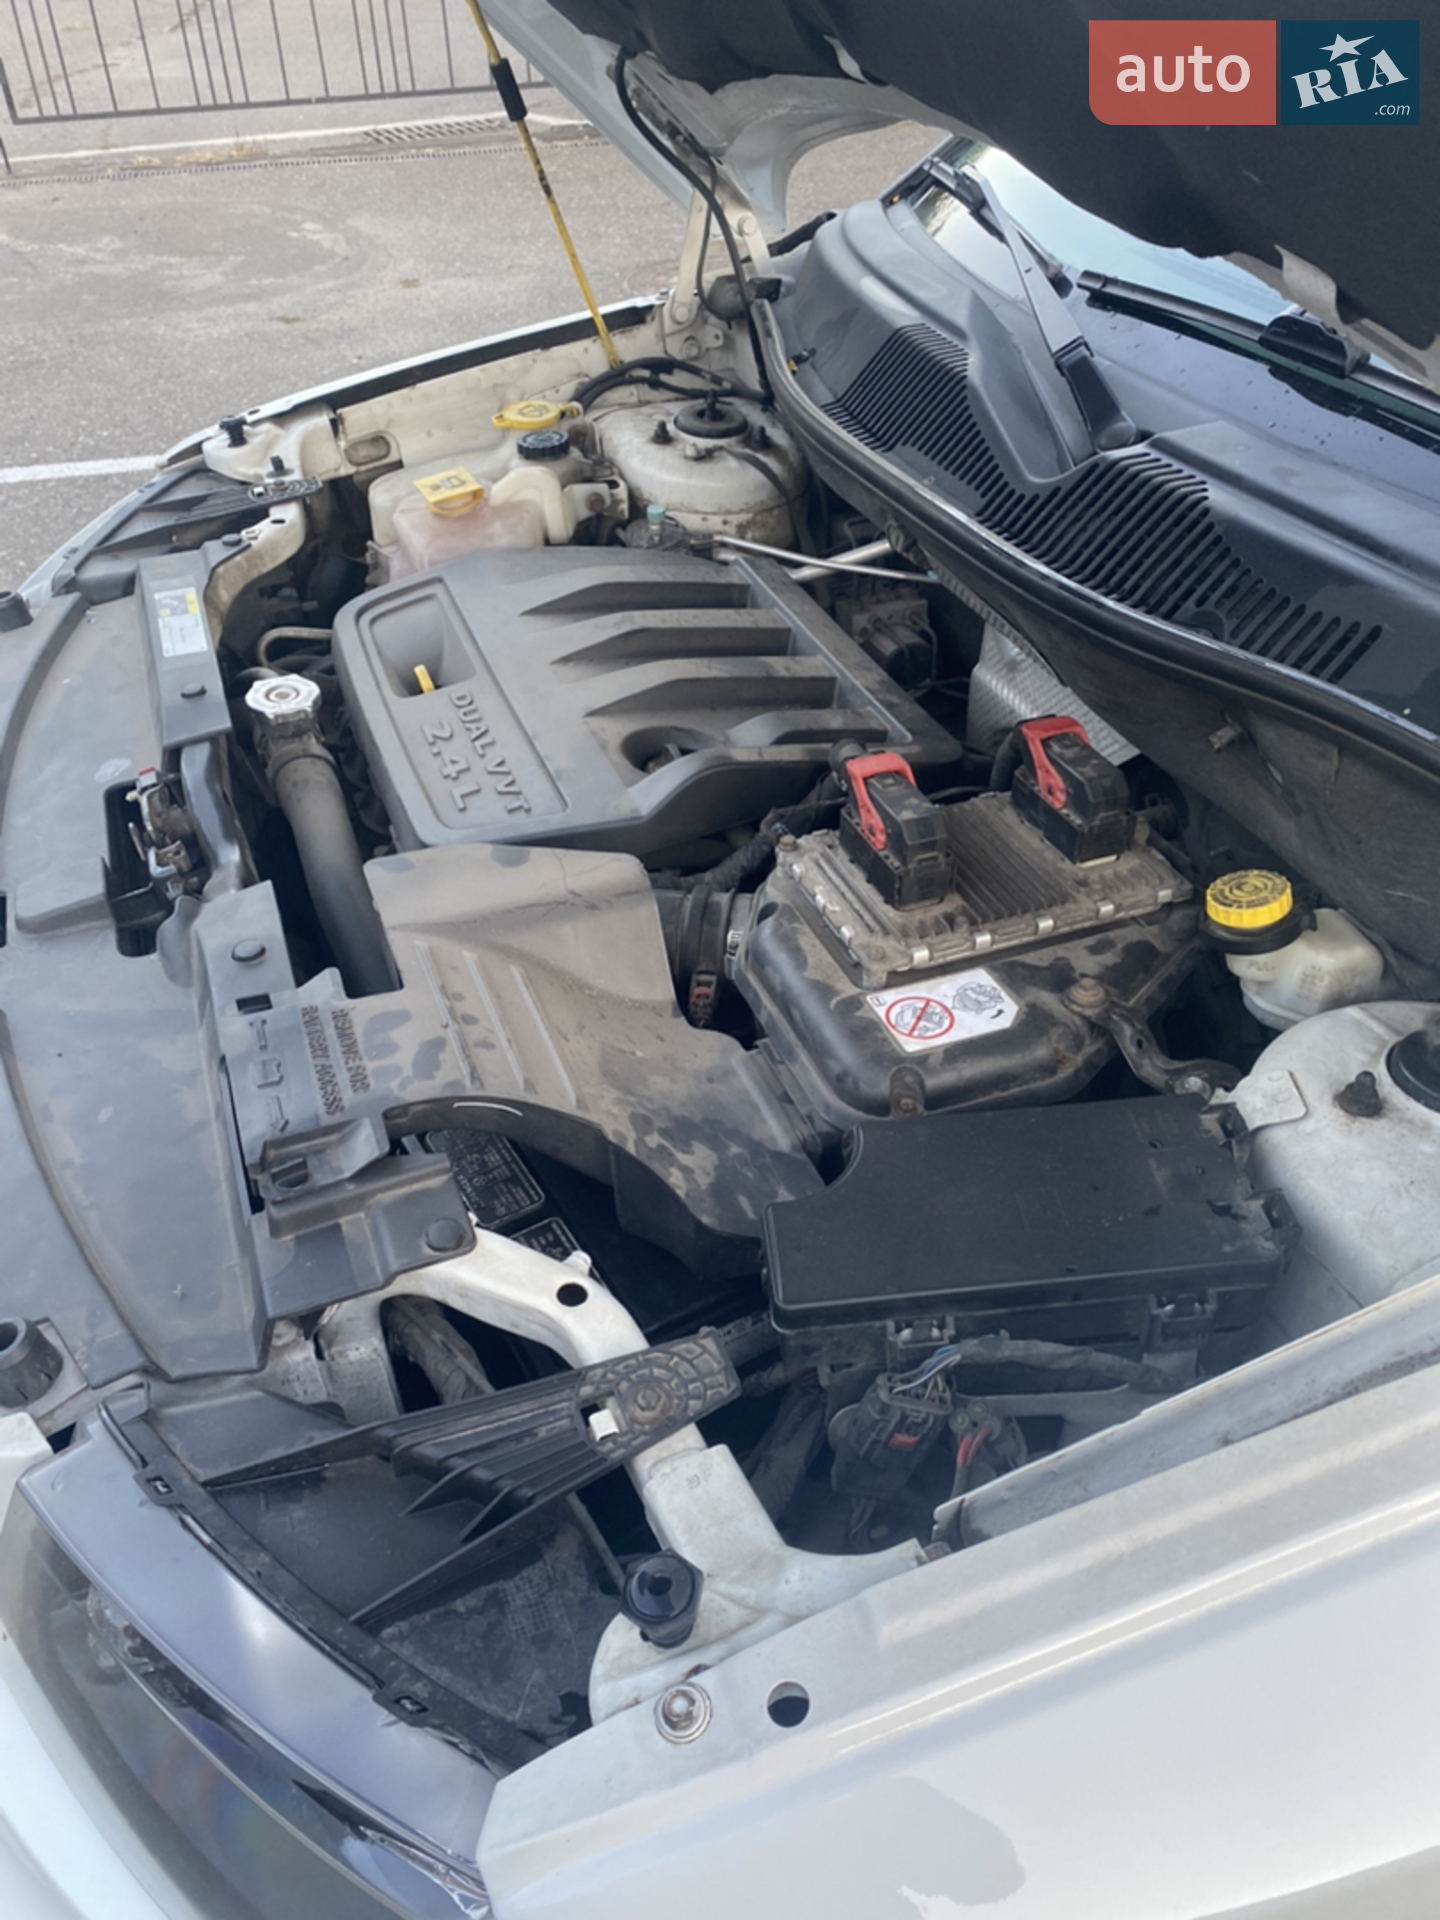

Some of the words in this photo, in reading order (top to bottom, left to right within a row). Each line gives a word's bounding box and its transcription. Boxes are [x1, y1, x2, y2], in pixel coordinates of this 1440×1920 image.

[421, 719, 471, 781] 2.4
[449, 781, 482, 813] L
[449, 689, 496, 758] DUAL
[485, 755, 532, 814] VVT
[301, 1004, 331, 1061] BATTERY
[330, 1008, 363, 1066] REMOVE
[313, 1063, 346, 1116] ACCESS
[345, 1063, 371, 1095] FOR
